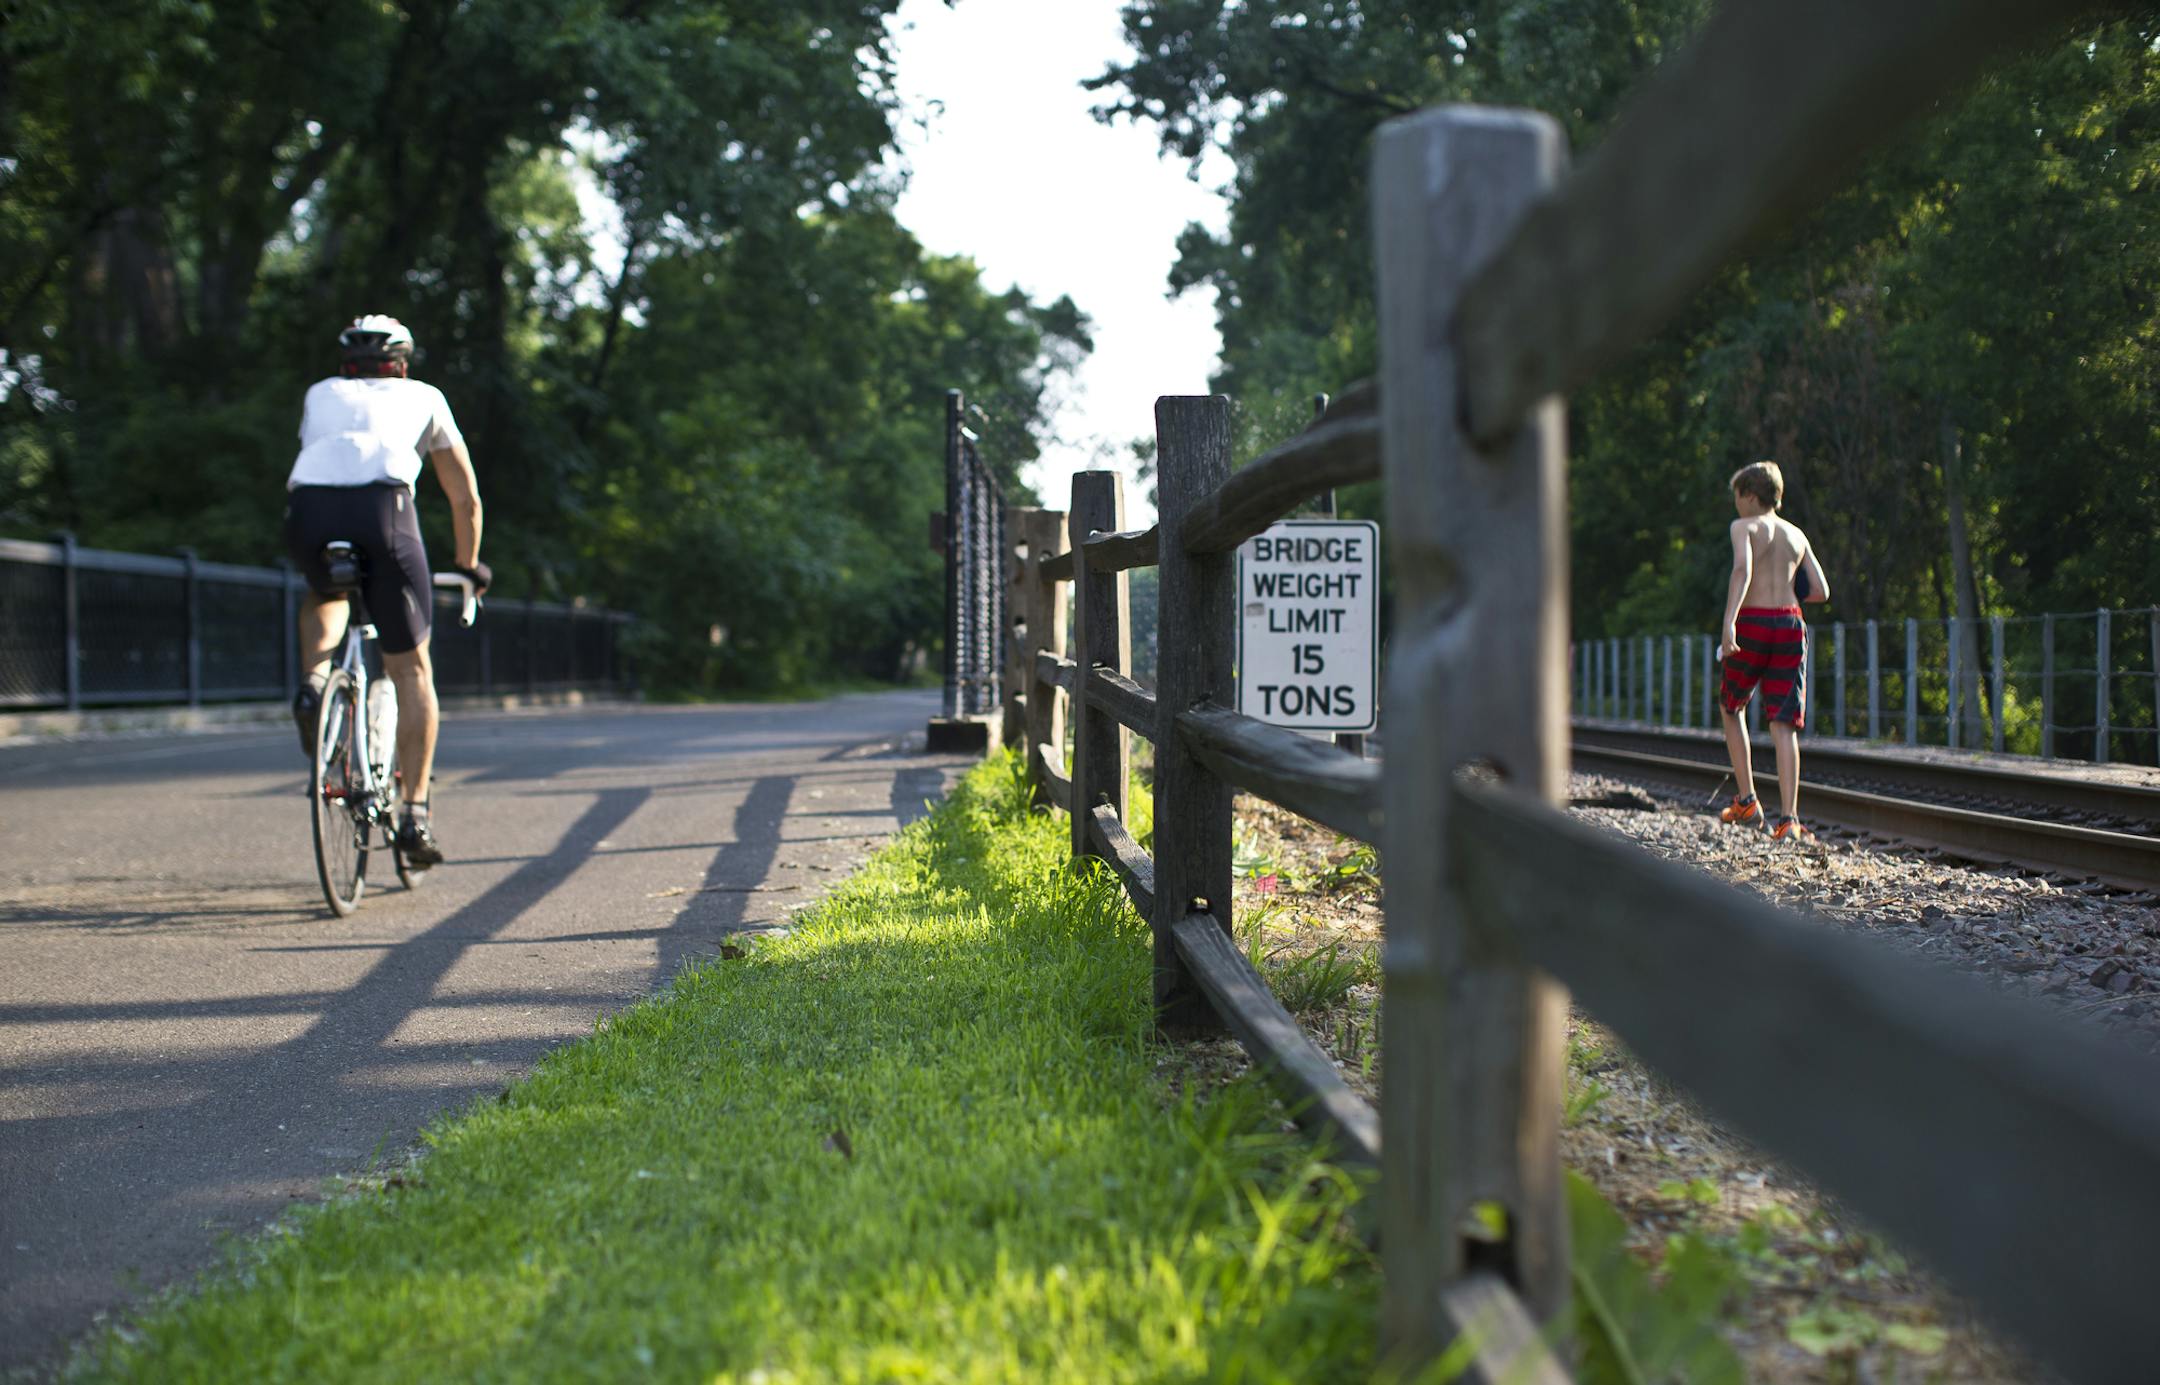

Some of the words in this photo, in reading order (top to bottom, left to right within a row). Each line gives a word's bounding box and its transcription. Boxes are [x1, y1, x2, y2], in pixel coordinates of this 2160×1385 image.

[1253, 538, 1362, 562] BRIDGE
[1253, 573, 1361, 598] WEIGHT
[1269, 608, 1345, 634] LIMIT
[1292, 644, 1324, 675] 15
[1257, 685, 1356, 716] TONS
